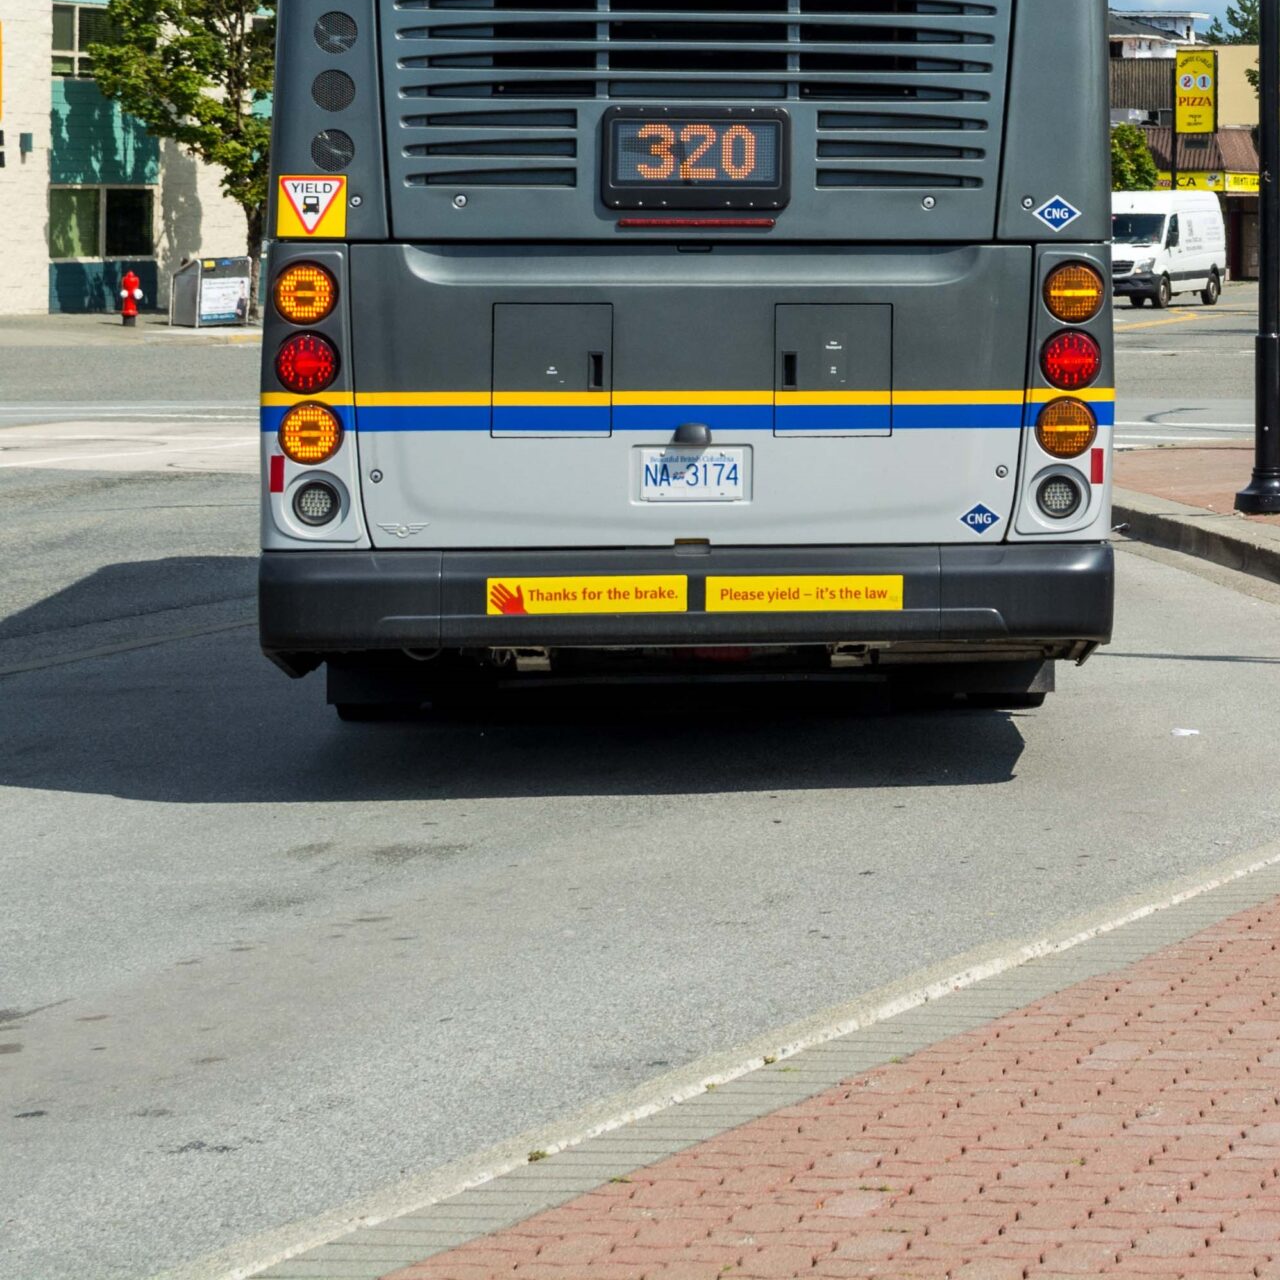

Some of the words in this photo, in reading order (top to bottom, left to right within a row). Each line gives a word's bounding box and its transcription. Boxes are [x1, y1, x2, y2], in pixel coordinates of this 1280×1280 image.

[1183, 75, 1191, 88] 2
[1178, 96, 1212, 107] PIZZA
[637, 124, 756, 179] 320
[291, 182, 333, 194] YIELD
[1044, 207, 1069, 220] CNG
[967, 513, 992, 525] CNG
[528, 588, 578, 602] Thanks
[581, 587, 603, 601] for
[607, 587, 630, 600] the
[635, 586, 678, 600] brake.
[720, 587, 765, 601] Please
[767, 587, 800, 603] yield
[815, 587, 836, 600] it's
[839, 587, 861, 600] the
[865, 587, 888, 600] law
